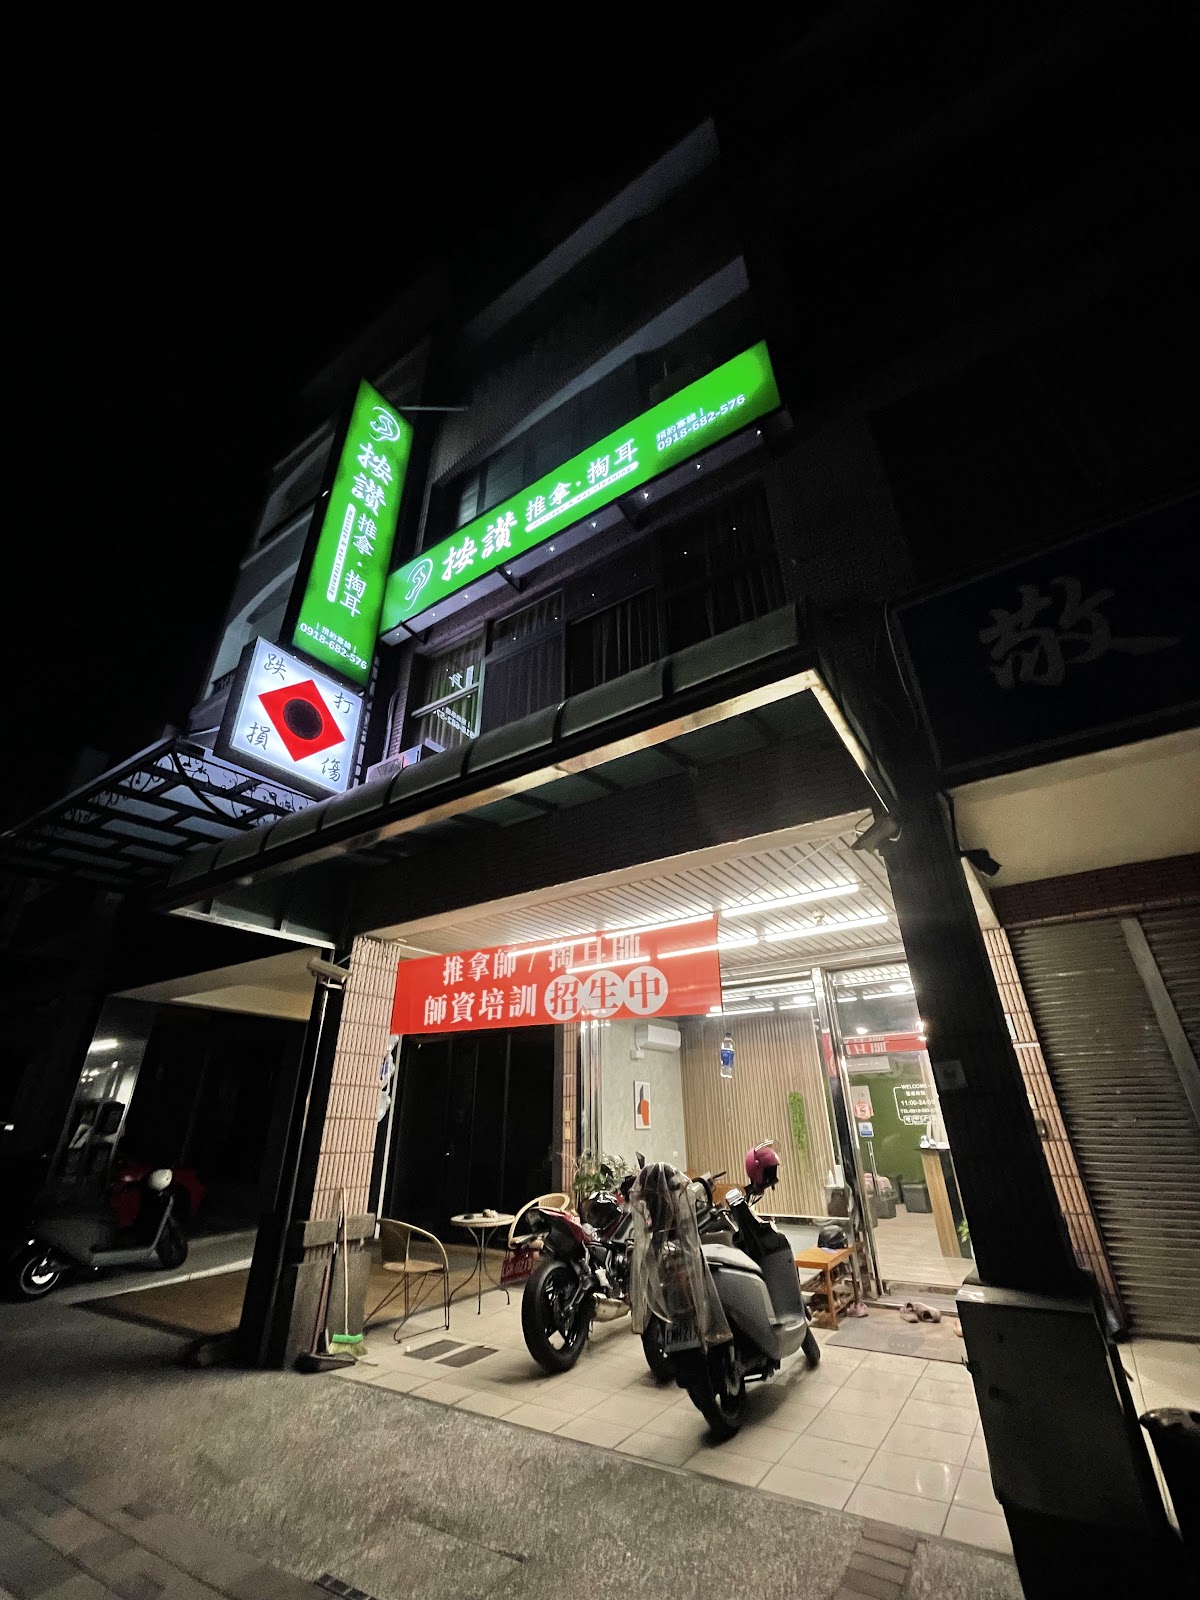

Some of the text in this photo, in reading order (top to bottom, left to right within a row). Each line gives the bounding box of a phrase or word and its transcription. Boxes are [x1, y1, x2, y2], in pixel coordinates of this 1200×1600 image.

[656, 393, 746, 452] 0918-682-576
[351, 442, 393, 517] 按讚
[343, 509, 353, 539] massage
[441, 511, 518, 582] 按讚
[328, 563, 341, 596] cleaning
[299, 622, 368, 670] 0918-682-576
[263, 653, 355, 714] 跌 打
[246, 721, 271, 750] 損
[442, 947, 518, 986] 推拿師
